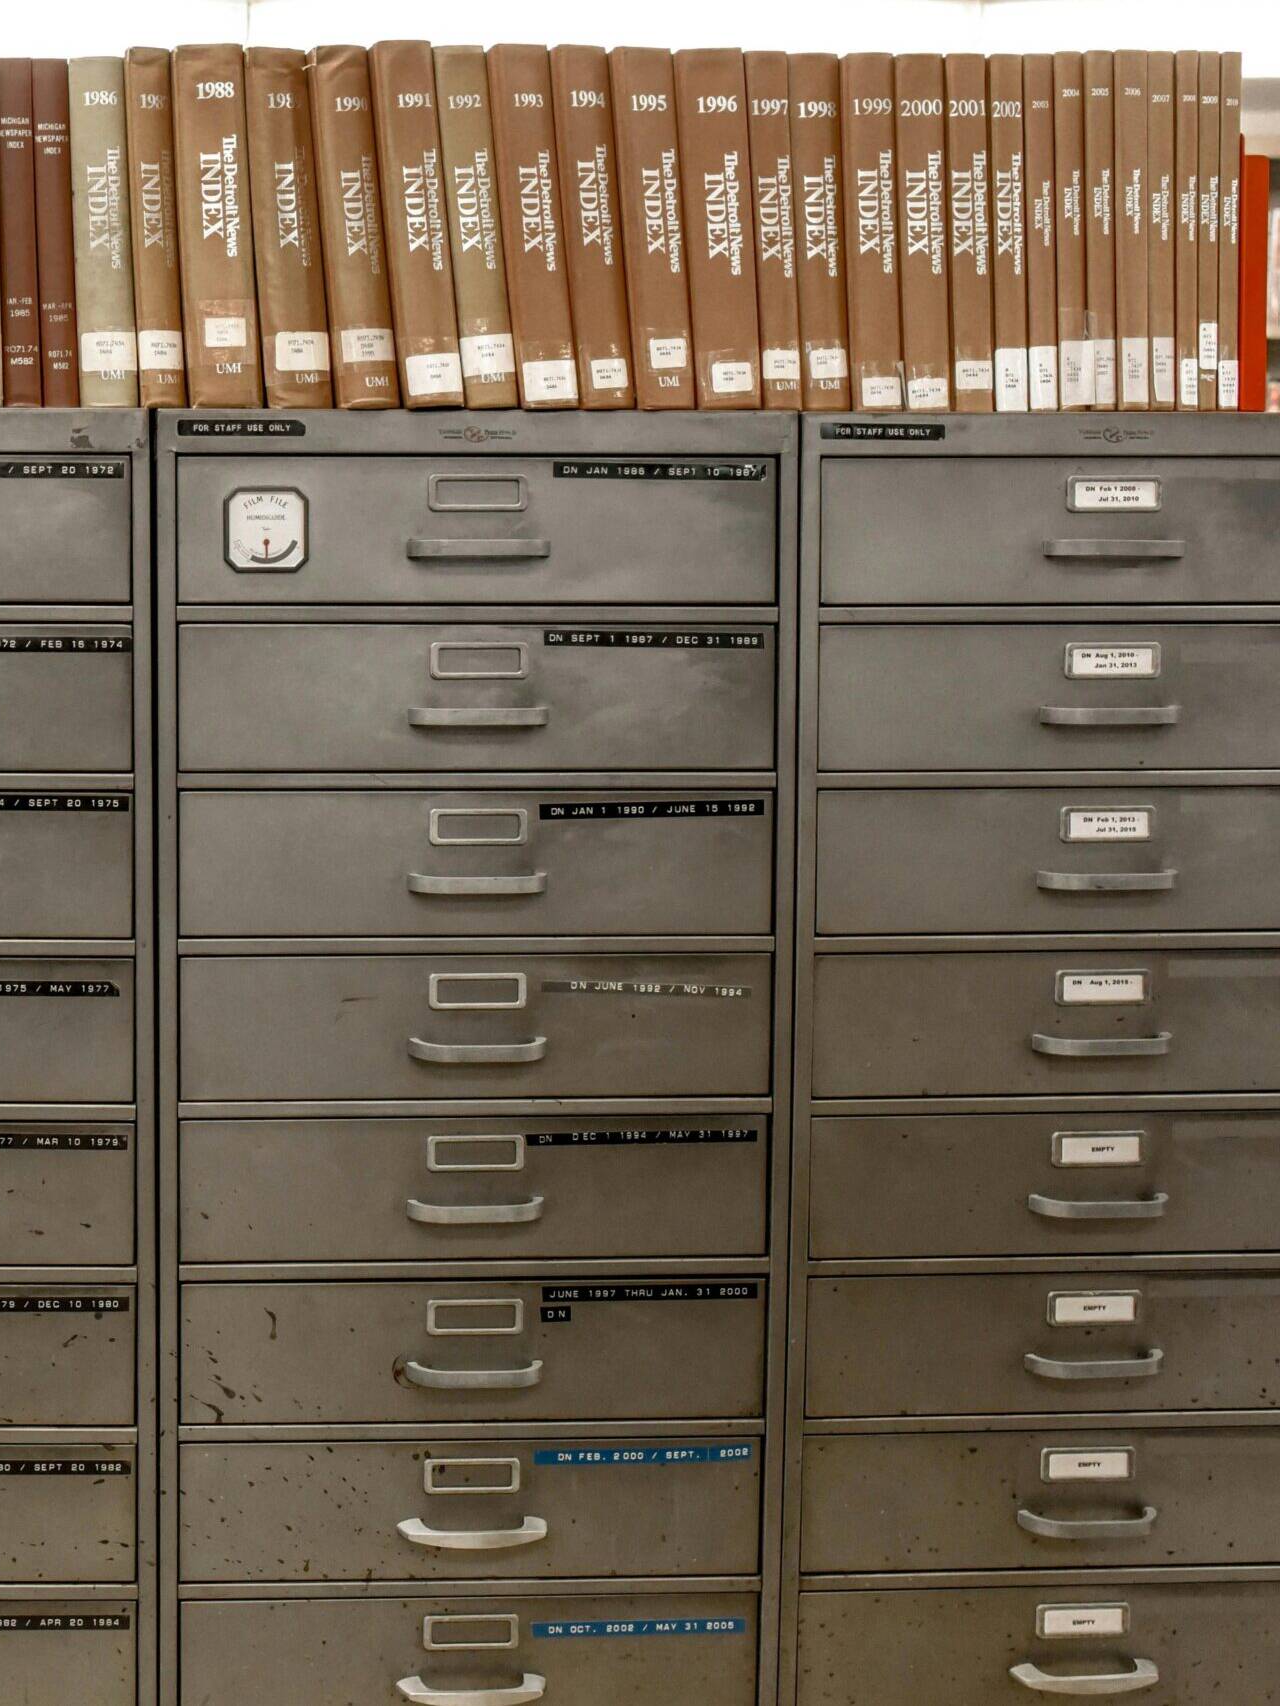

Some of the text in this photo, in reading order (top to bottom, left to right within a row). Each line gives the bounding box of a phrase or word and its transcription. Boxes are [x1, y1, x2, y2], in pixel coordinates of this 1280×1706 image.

[83, 90, 118, 107] 1986
[196, 82, 234, 100] 1988
[570, 91, 604, 107] 1994
[1091, 88, 1109, 96] 2005
[1124, 87, 1141, 96] 2006
[1152, 94, 1170, 103] 2007
[398, 93, 432, 108] 1991
[448, 94, 482, 109] 1992
[514, 93, 543, 108] 1993
[631, 94, 667, 111] 1995
[696, 95, 738, 113] 1996
[752, 99, 788, 116] 1997
[853, 98, 892, 116] 1999
[901, 99, 942, 116] 2000
[950, 99, 985, 117] 2001
[992, 101, 1021, 118] 2002
[798, 102, 836, 118] 1998
[140, 161, 164, 248] INDEX
[200, 152, 224, 240] INDEX
[222, 134, 240, 258] The Detroit News
[1064, 188, 1072, 219] INDEX
[87, 164, 110, 250] INDEX
[402, 165, 429, 252] INDEX
[454, 165, 482, 252] INDEX
[518, 166, 543, 253] INDEX
[538, 149, 556, 272] The Detroit News
[642, 168, 665, 255] INDEX
[662, 148, 681, 273] The Detroit News
[704, 172, 729, 260] INDEX
[724, 151, 743, 276] The Detroit News
[858, 169, 880, 255] INDEX
[906, 170, 929, 256] INDEX
[928, 150, 944, 274] The Detroit News
[952, 170, 974, 256] INDEX
[997, 170, 1012, 256] INDEX
[1152, 192, 1161, 224] INDEX
[758, 176, 782, 261] INDEX
[216, 362, 242, 374] UMI
[551, 807, 564, 815] DN
[572, 807, 593, 815] JAN
[619, 806, 644, 814] 1990
[667, 805, 695, 813] JUNE
[706, 805, 718, 813] 15
[728, 804, 756, 812] 1992
[0, 984, 26, 992] 1975
[550, 1290, 578, 1298] JUNE
[697, 1288, 709, 1296] 31
[549, 1626, 562, 1634] DN
[607, 1624, 633, 1632] 2002
